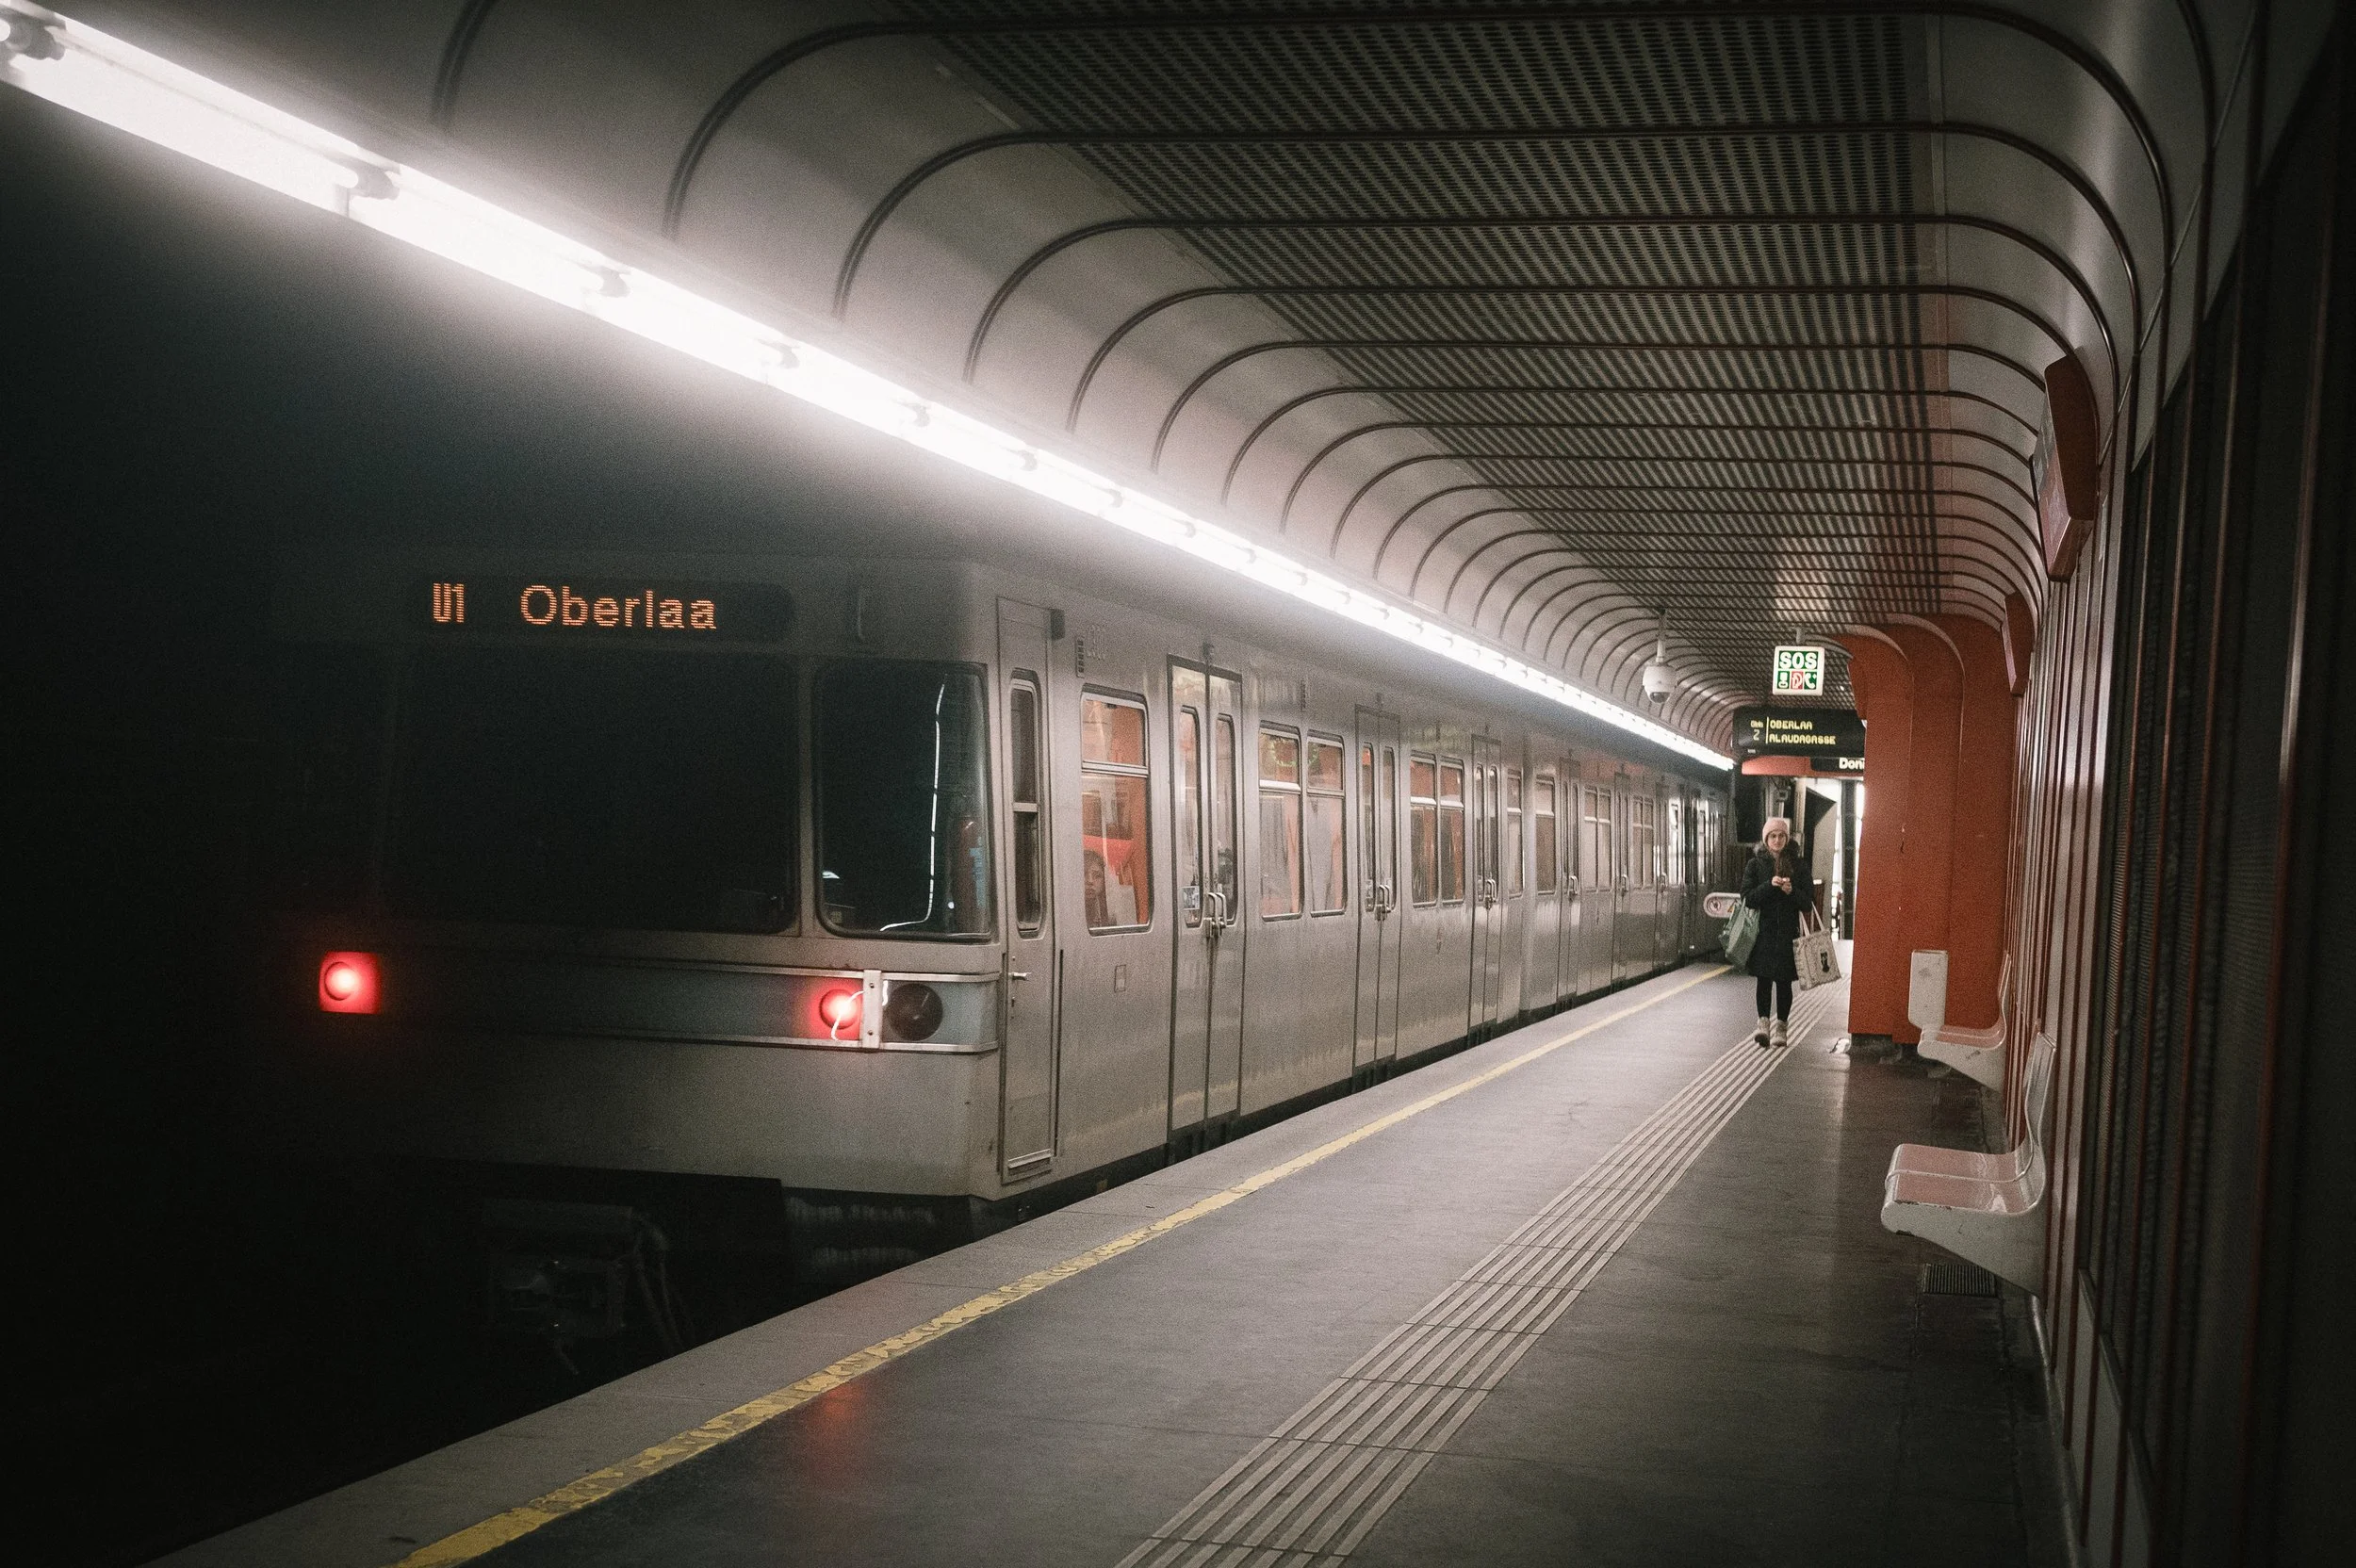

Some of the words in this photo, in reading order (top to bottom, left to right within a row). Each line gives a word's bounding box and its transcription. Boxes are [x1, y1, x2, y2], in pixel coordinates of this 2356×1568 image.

[433, 582, 465, 624] U1
[520, 584, 716, 629] Oberlaa
[1779, 651, 1817, 670] SOS
[1770, 719, 1813, 730] OBERLAA
[1753, 728, 1760, 742] 2
[1769, 733, 1836, 745] ALAUDAGASSE
